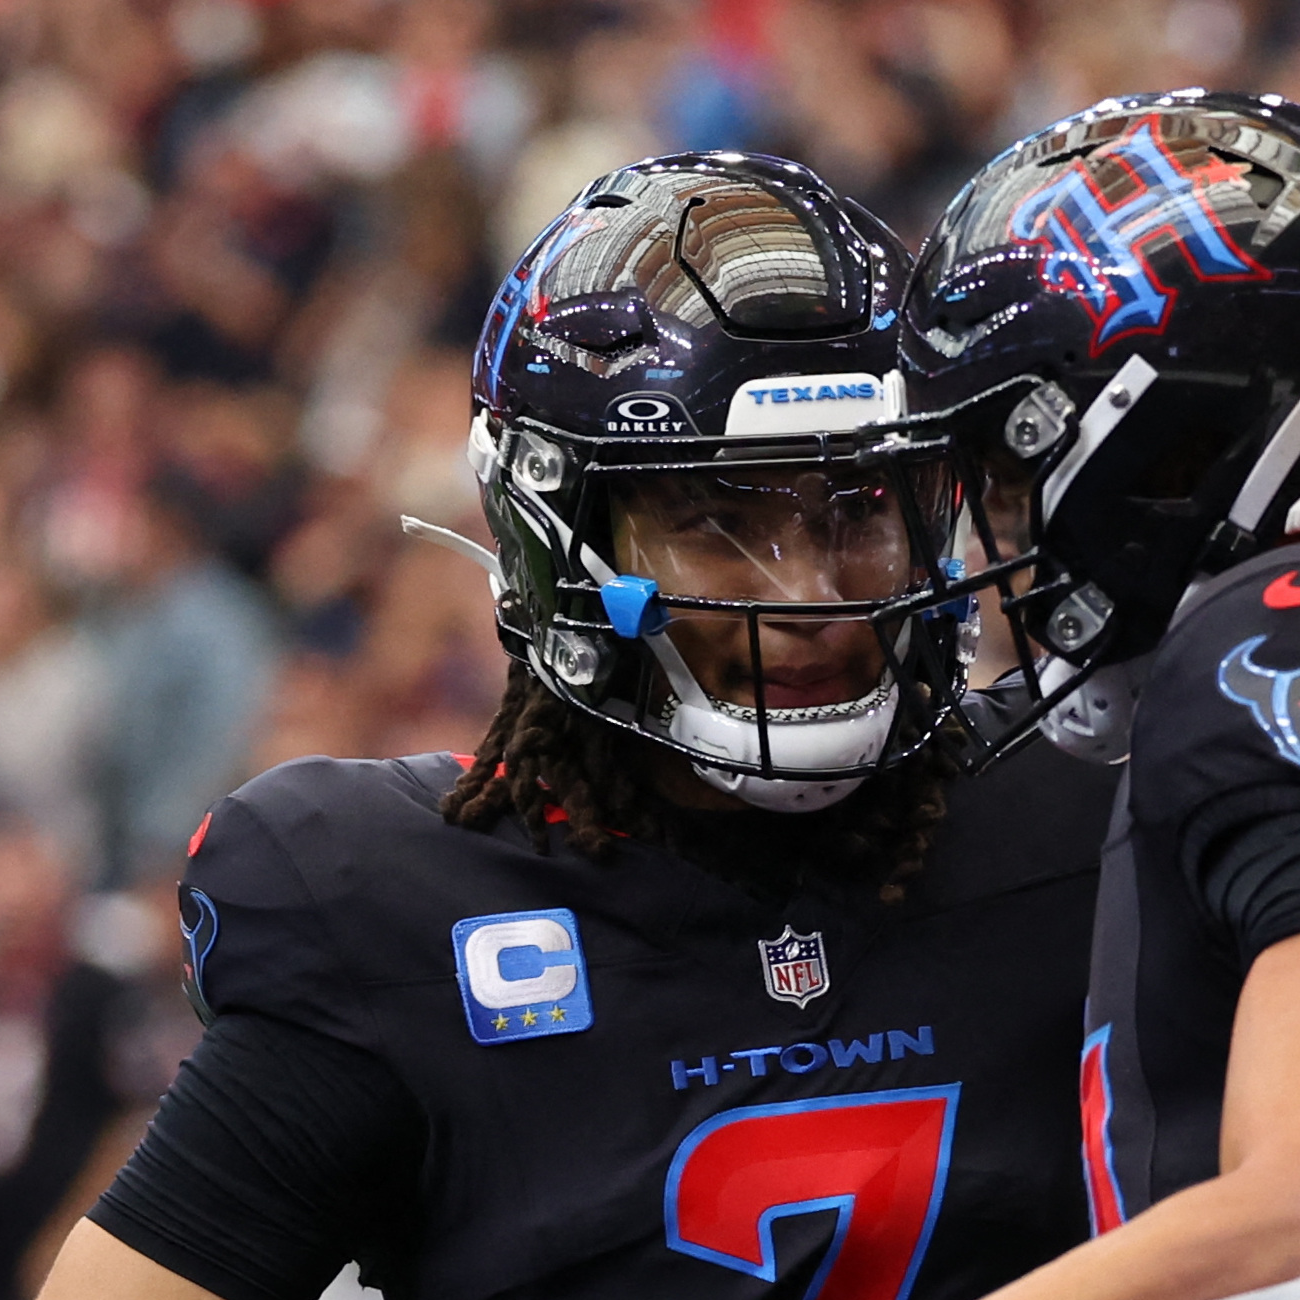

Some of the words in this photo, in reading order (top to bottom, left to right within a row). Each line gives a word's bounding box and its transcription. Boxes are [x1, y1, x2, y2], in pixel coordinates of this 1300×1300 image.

[746, 382, 876, 406] TEXANS
[606, 421, 683, 434] OAKLEY
[465, 918, 577, 1010] C
[775, 961, 819, 993] NFL
[671, 1025, 935, 1090] H-TOWN
